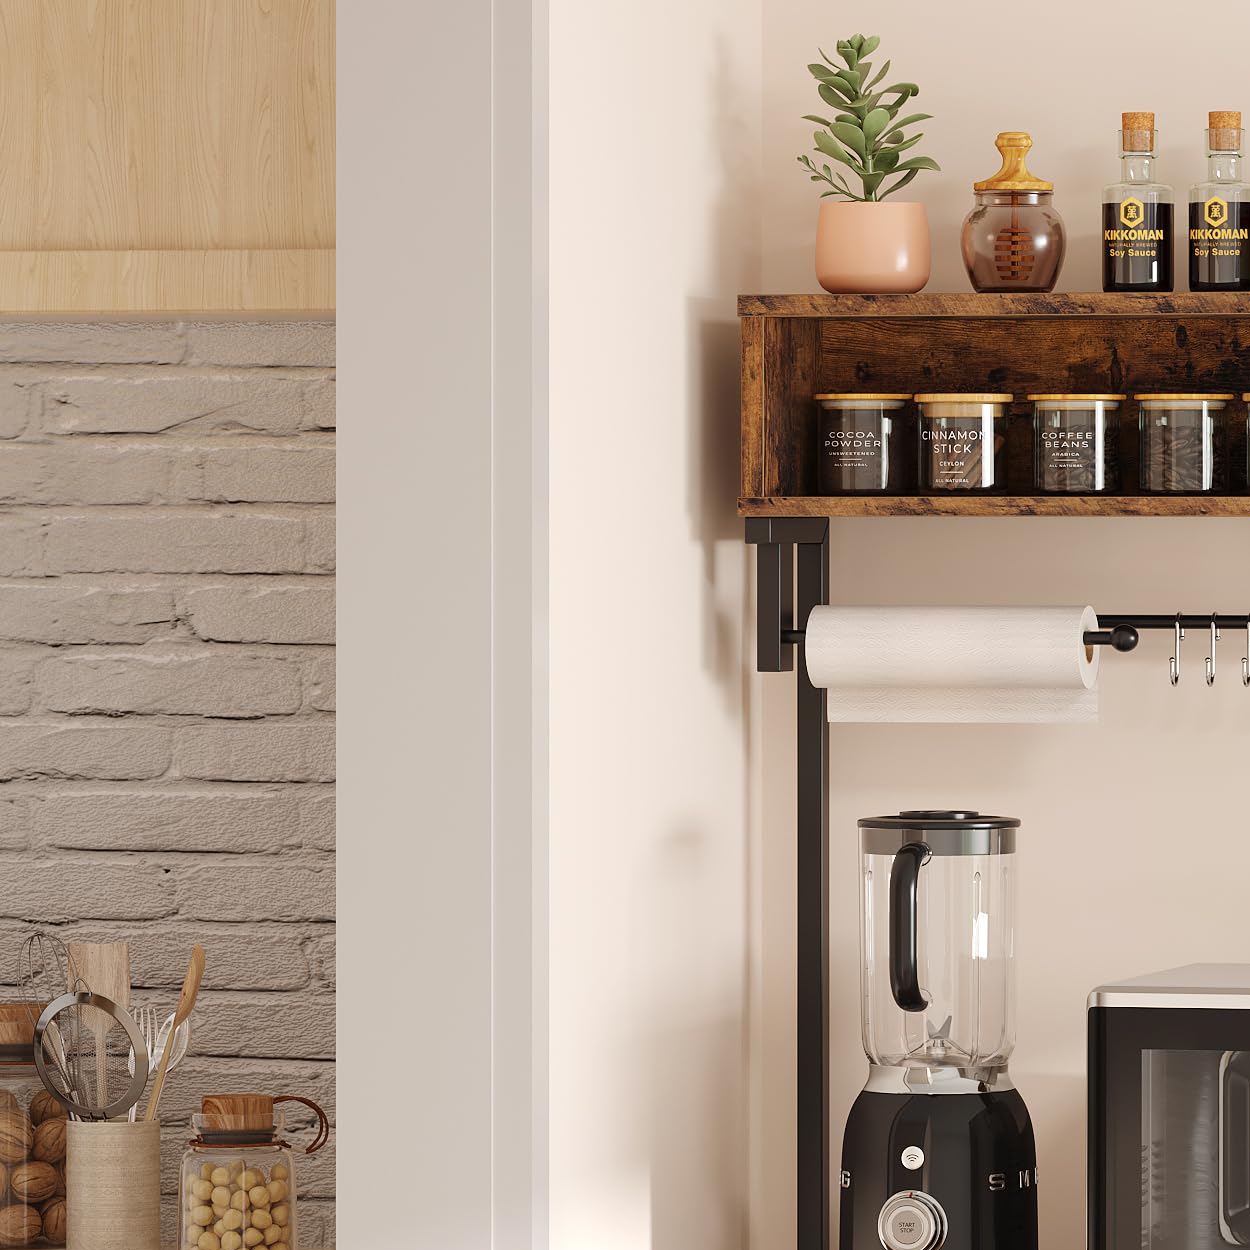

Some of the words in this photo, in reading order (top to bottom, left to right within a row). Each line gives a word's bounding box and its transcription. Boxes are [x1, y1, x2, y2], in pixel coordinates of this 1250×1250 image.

[1104, 229, 1164, 241] KIKKOMAN
[1189, 228, 1249, 240] KIKKOMAN
[1109, 248, 1125, 259] Soy
[1127, 248, 1156, 257] Sauce
[1194, 247, 1209, 258] Soy
[1211, 247, 1241, 256] Sauce
[829, 431, 875, 439] COCOA
[921, 430, 986, 440] CINNAMON
[1041, 432, 1093, 440] COFFEE
[933, 443, 972, 454] STICK
